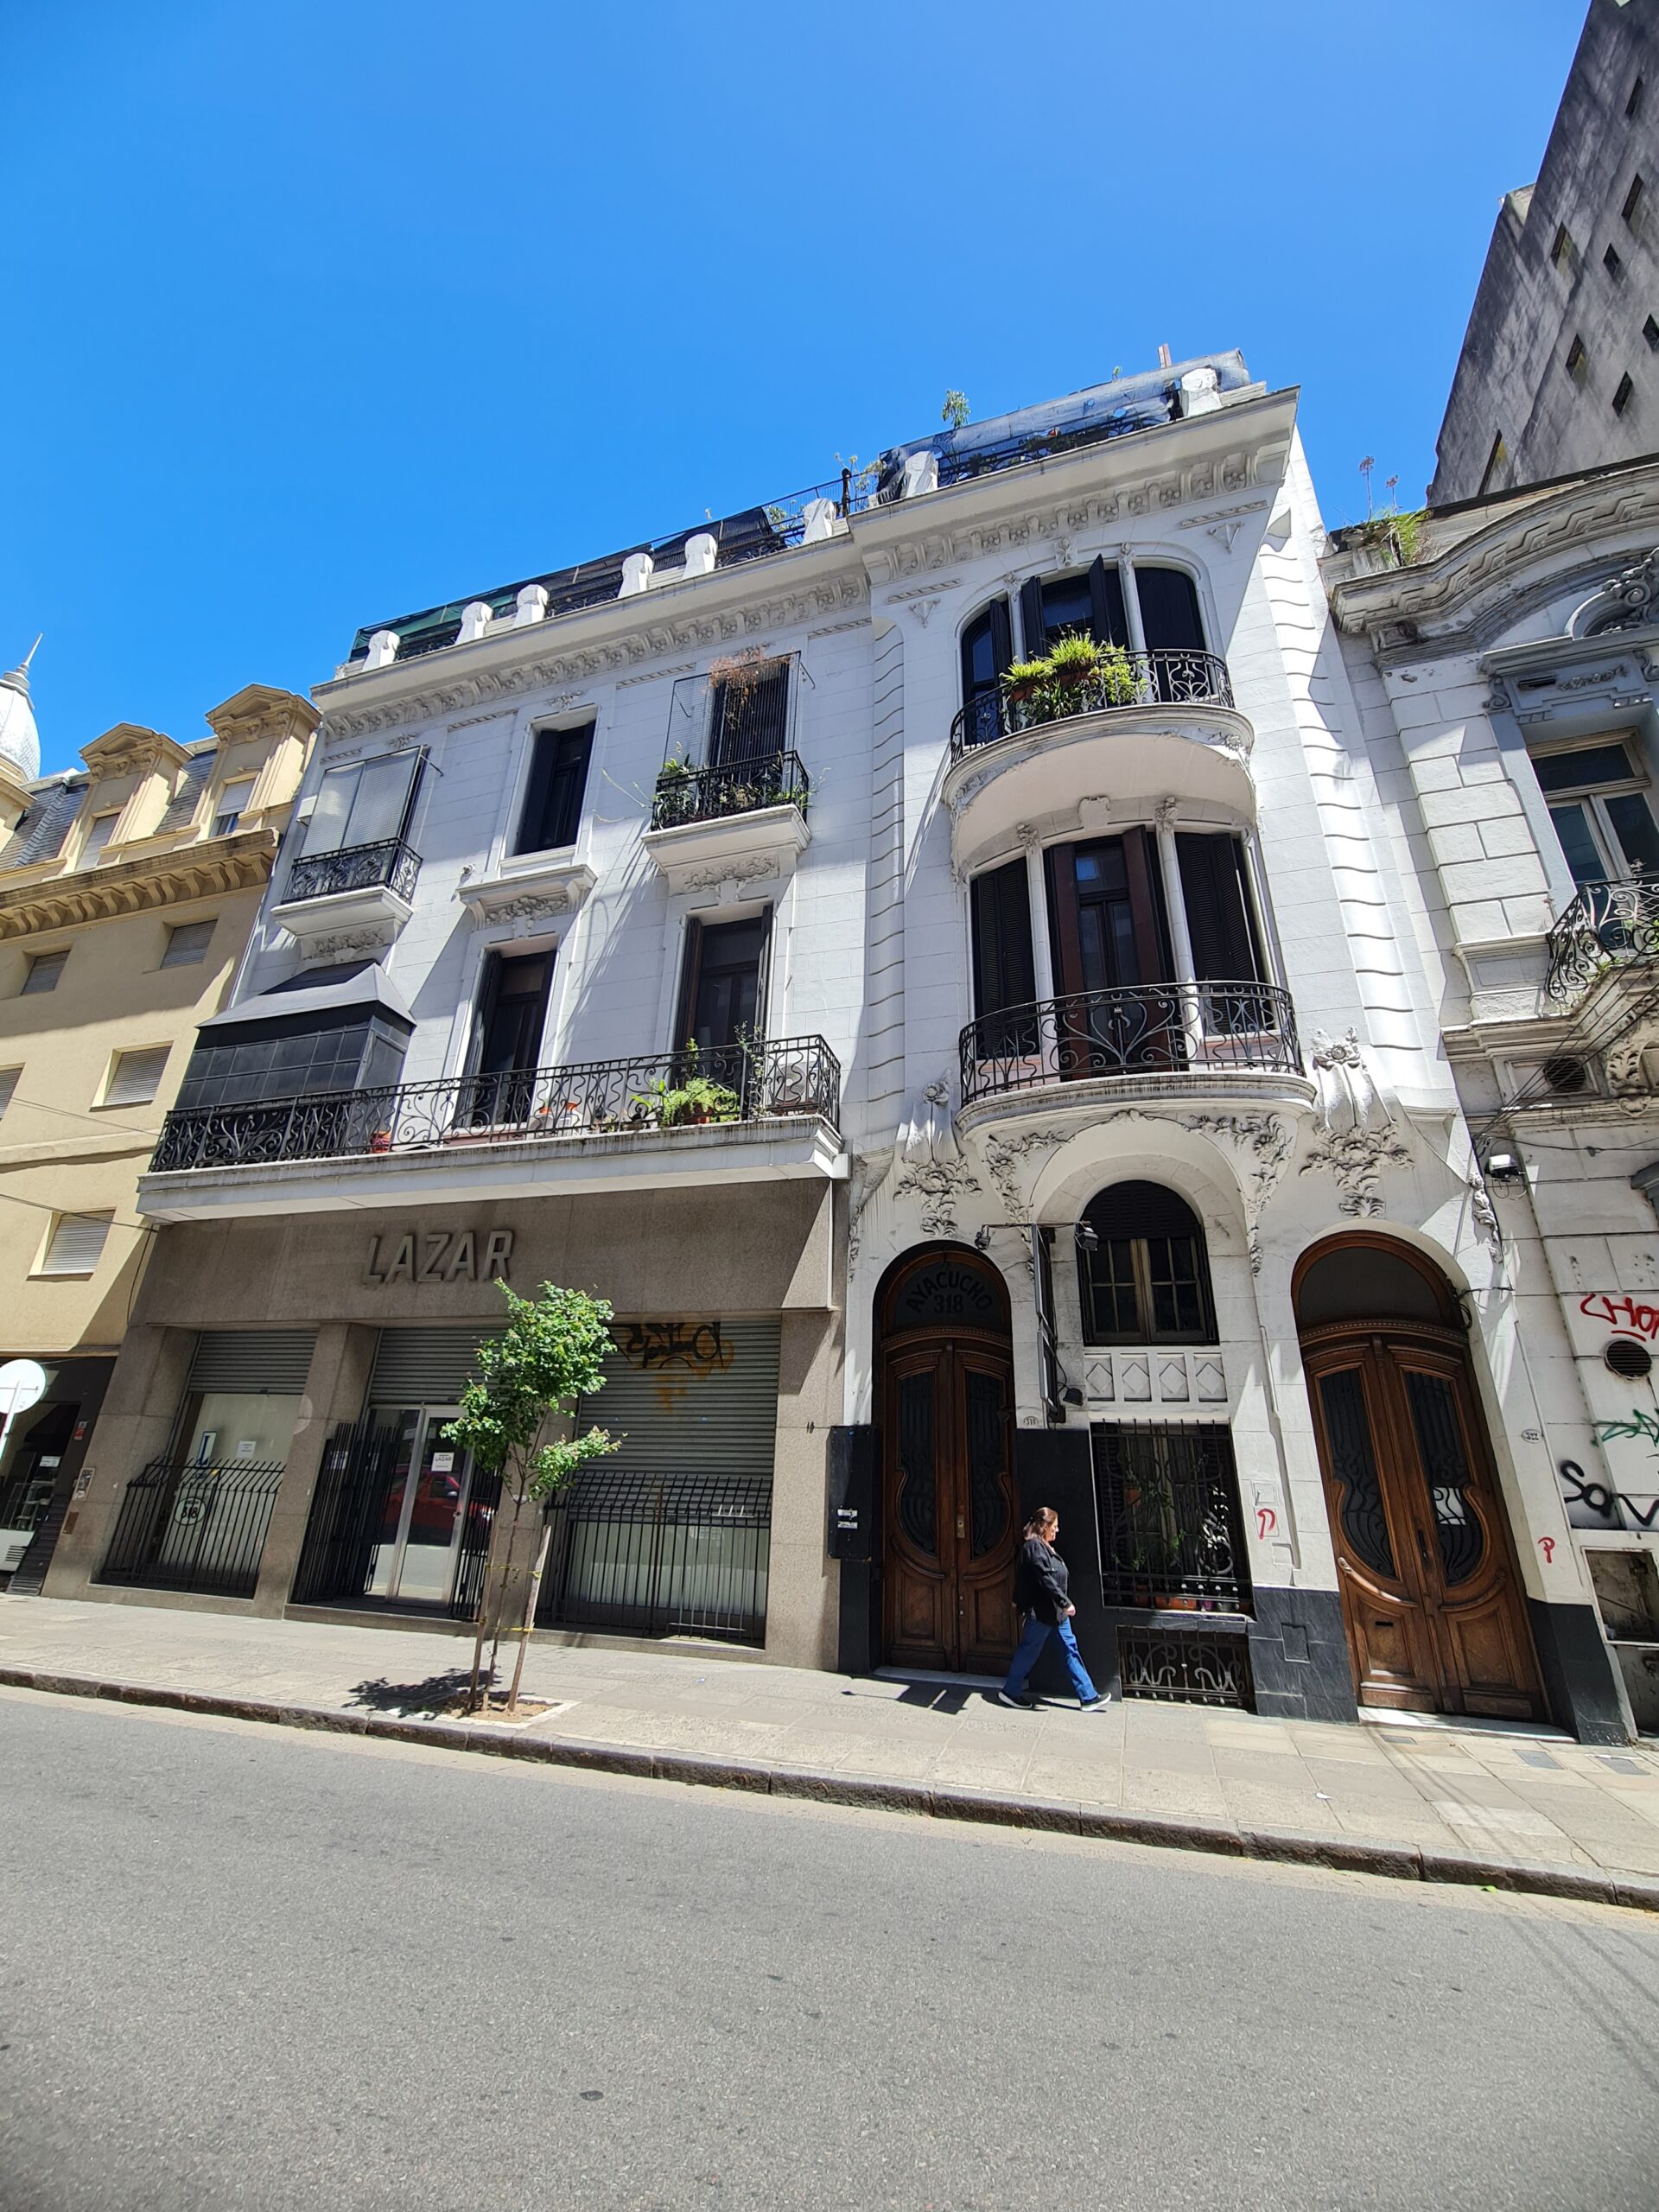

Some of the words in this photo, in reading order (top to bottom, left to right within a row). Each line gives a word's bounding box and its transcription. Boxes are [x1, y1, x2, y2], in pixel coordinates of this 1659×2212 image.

[363, 1230, 515, 1285] LAZAR
[906, 1271, 994, 1314] AYACUCHO
[934, 1294, 964, 1313] 318
